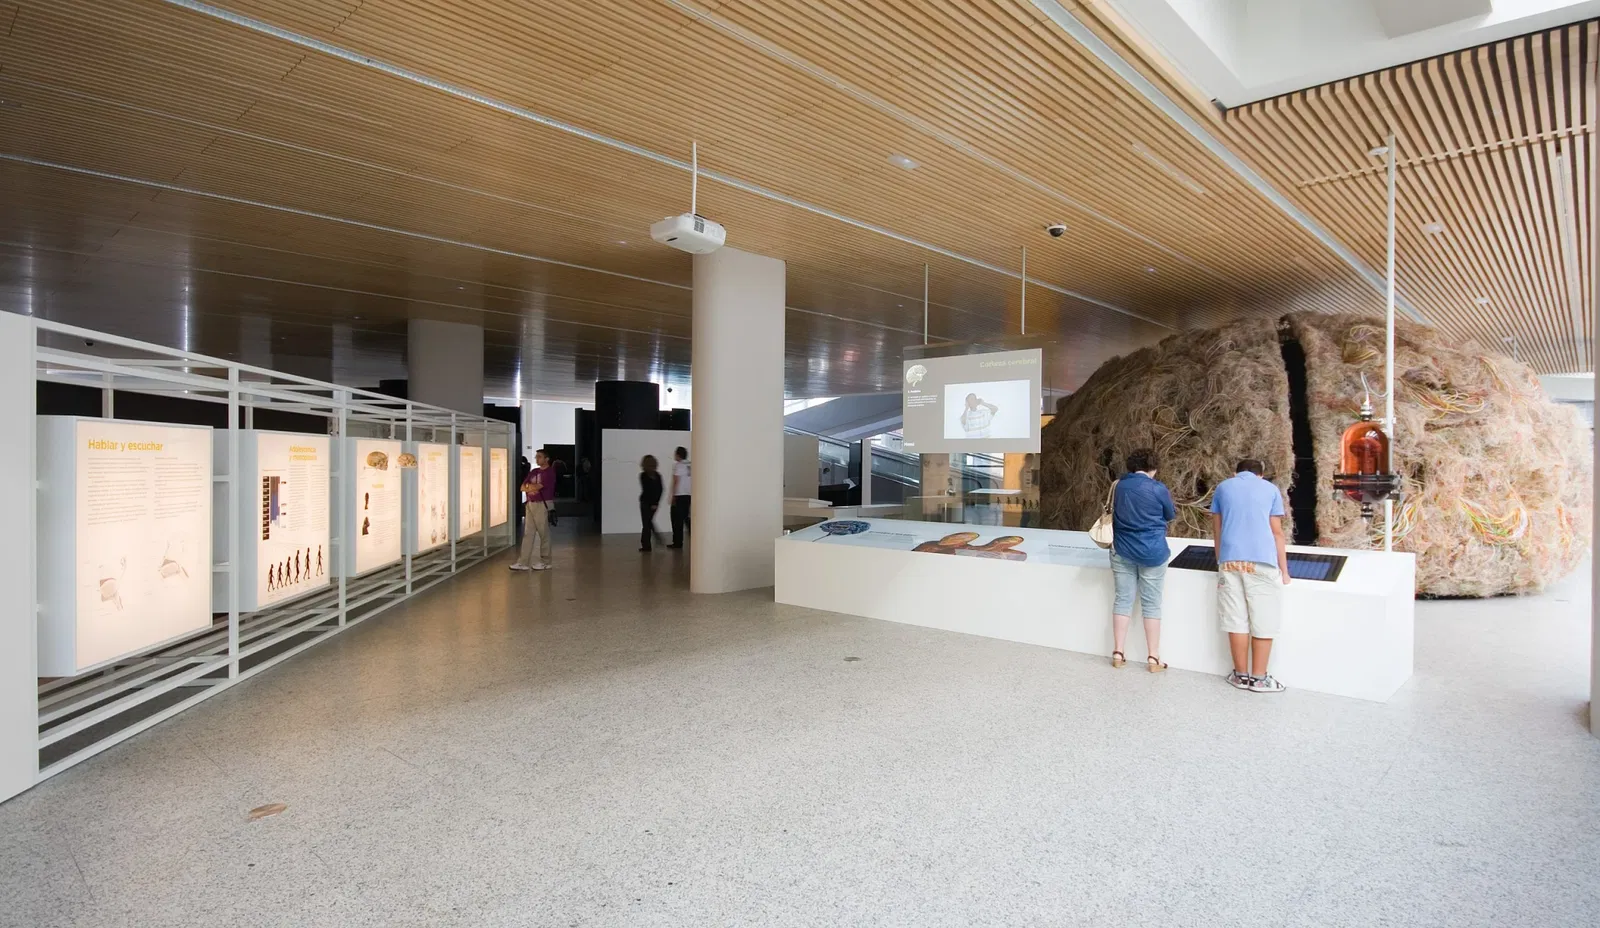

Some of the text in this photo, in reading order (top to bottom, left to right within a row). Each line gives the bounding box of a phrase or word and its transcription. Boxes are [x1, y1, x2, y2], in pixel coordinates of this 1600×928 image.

[979, 357, 1037, 368] Corteza cerebral
[88, 439, 164, 452] Hablar y escuchar
